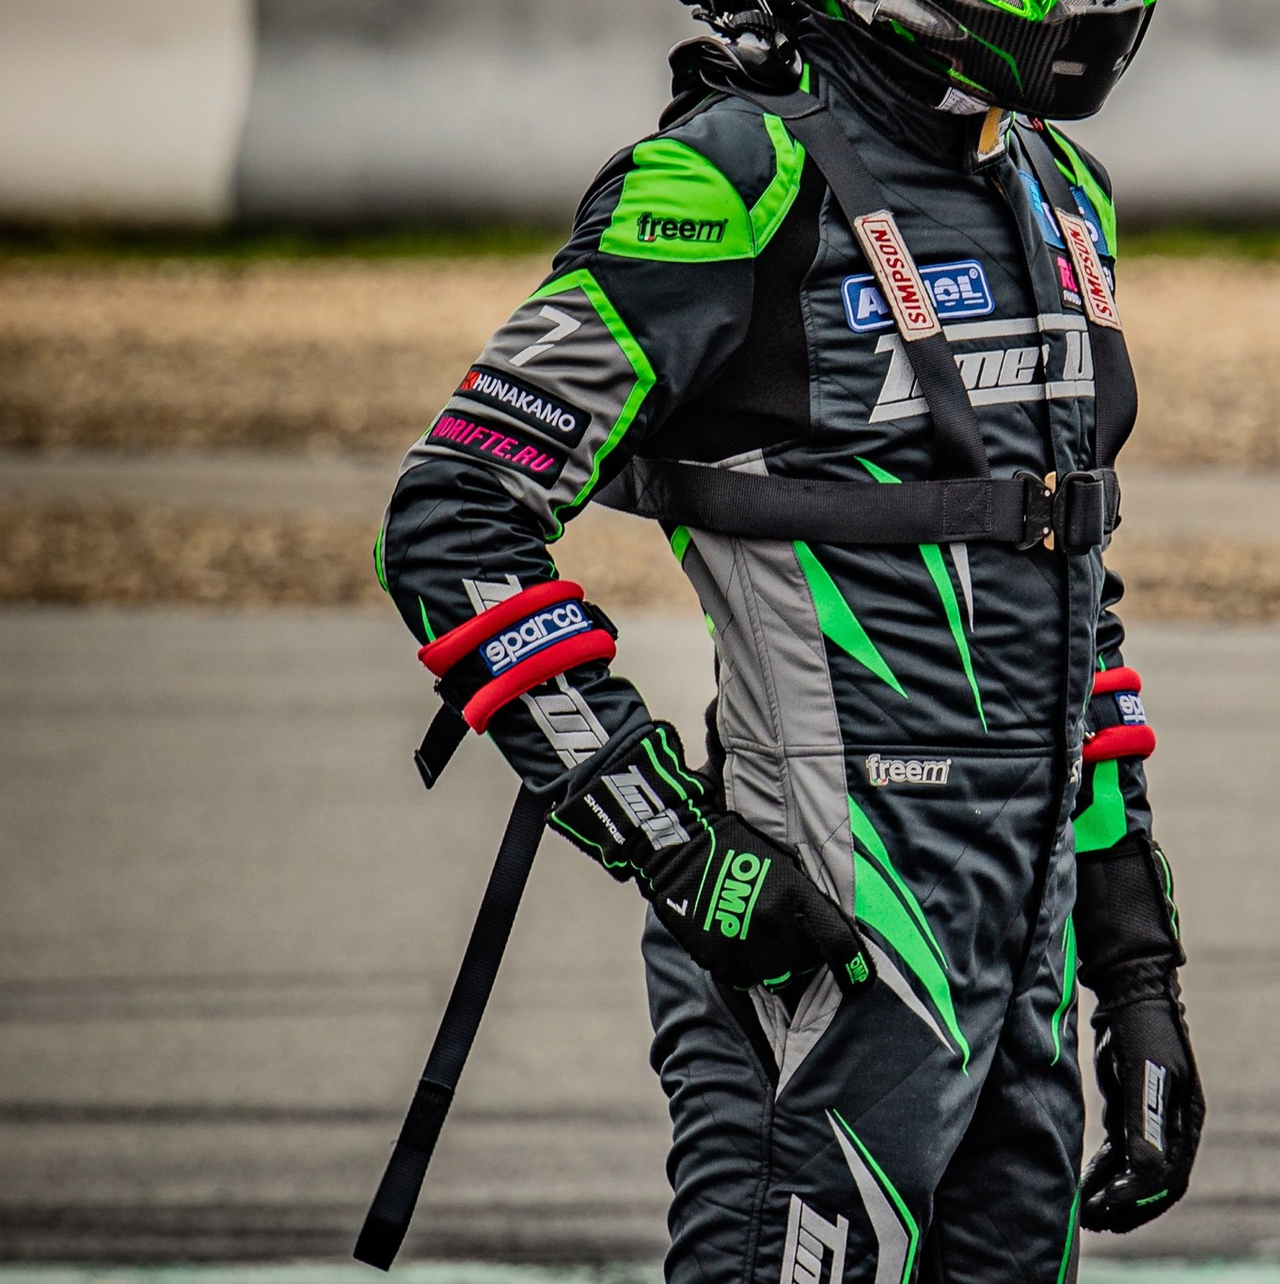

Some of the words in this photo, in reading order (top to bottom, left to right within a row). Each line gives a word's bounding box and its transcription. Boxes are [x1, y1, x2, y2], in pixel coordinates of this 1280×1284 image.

[637, 212, 728, 243] freem
[869, 228, 927, 325] SIMPSON
[1068, 226, 1113, 318] SIMPSON
[508, 305, 582, 367] 7
[485, 603, 588, 672] sparco
[865, 753, 952, 786] freem
[714, 852, 761, 938] OMP
